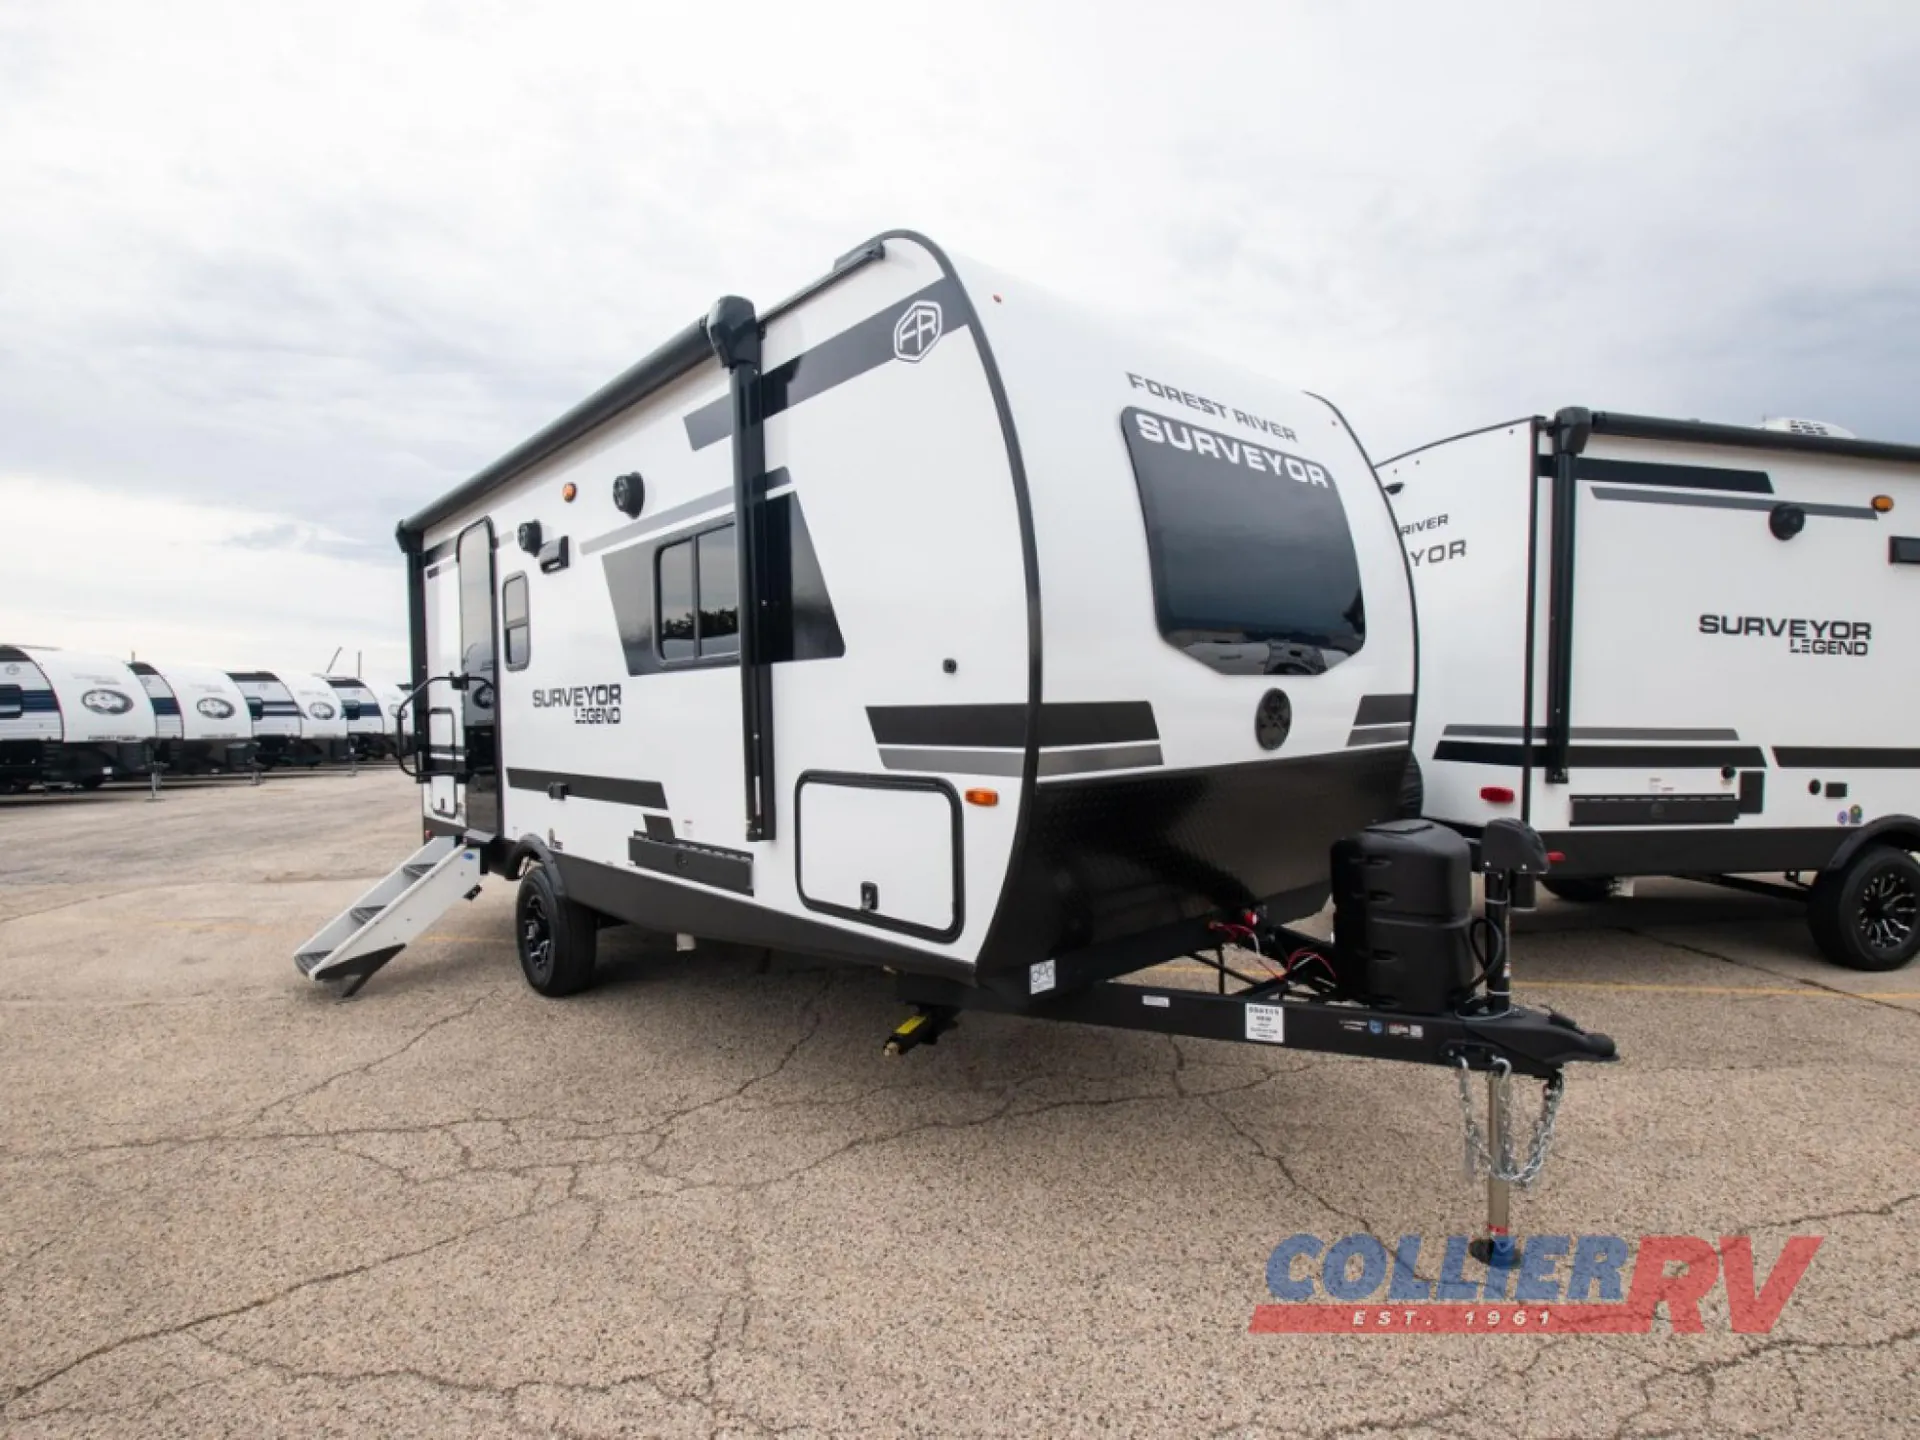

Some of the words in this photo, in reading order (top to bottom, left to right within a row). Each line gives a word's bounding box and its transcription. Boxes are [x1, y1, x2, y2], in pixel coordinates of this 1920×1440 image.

[1126, 372, 1227, 419] FOREST
[1232, 408, 1298, 442] RIVER
[1135, 413, 1329, 488] SURVEYOR
[1400, 513, 1449, 535] RIVER
[1699, 613, 1872, 640] SURVEYOR
[1789, 639, 1868, 656] LEGEND
[532, 683, 622, 708] SURVEYOR
[574, 707, 621, 724] LEGEND
